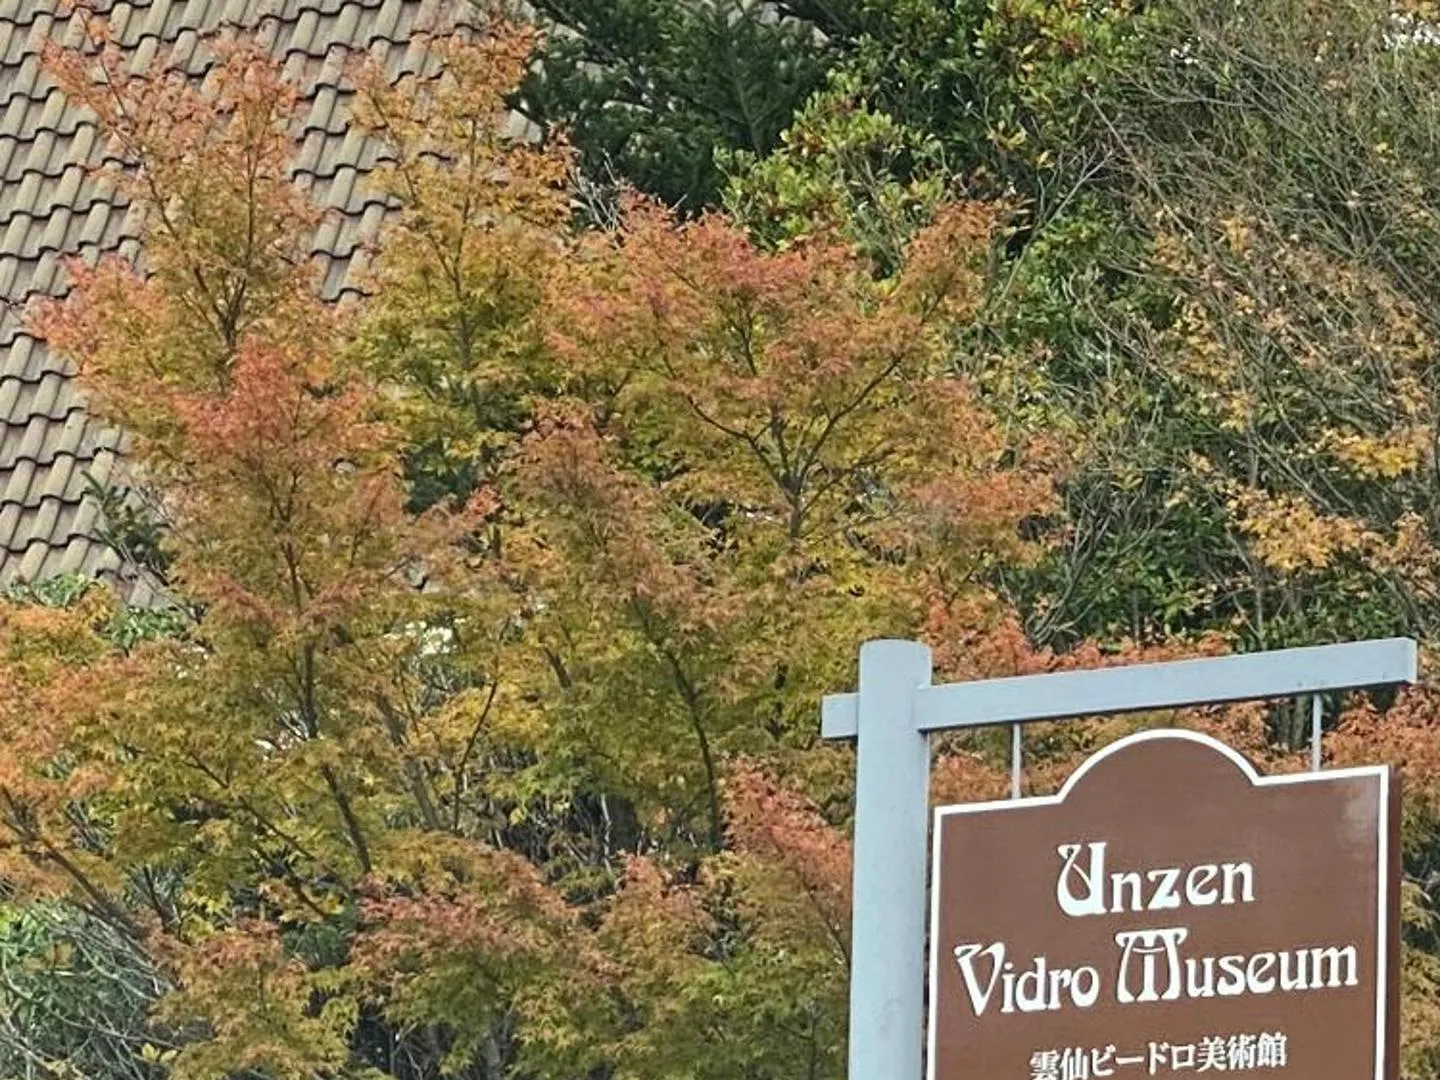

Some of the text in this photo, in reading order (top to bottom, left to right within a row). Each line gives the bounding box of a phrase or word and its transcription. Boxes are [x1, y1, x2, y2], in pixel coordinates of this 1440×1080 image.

[1057, 841, 1255, 916] Unzen
[953, 927, 1359, 1016] Vidro Museum
